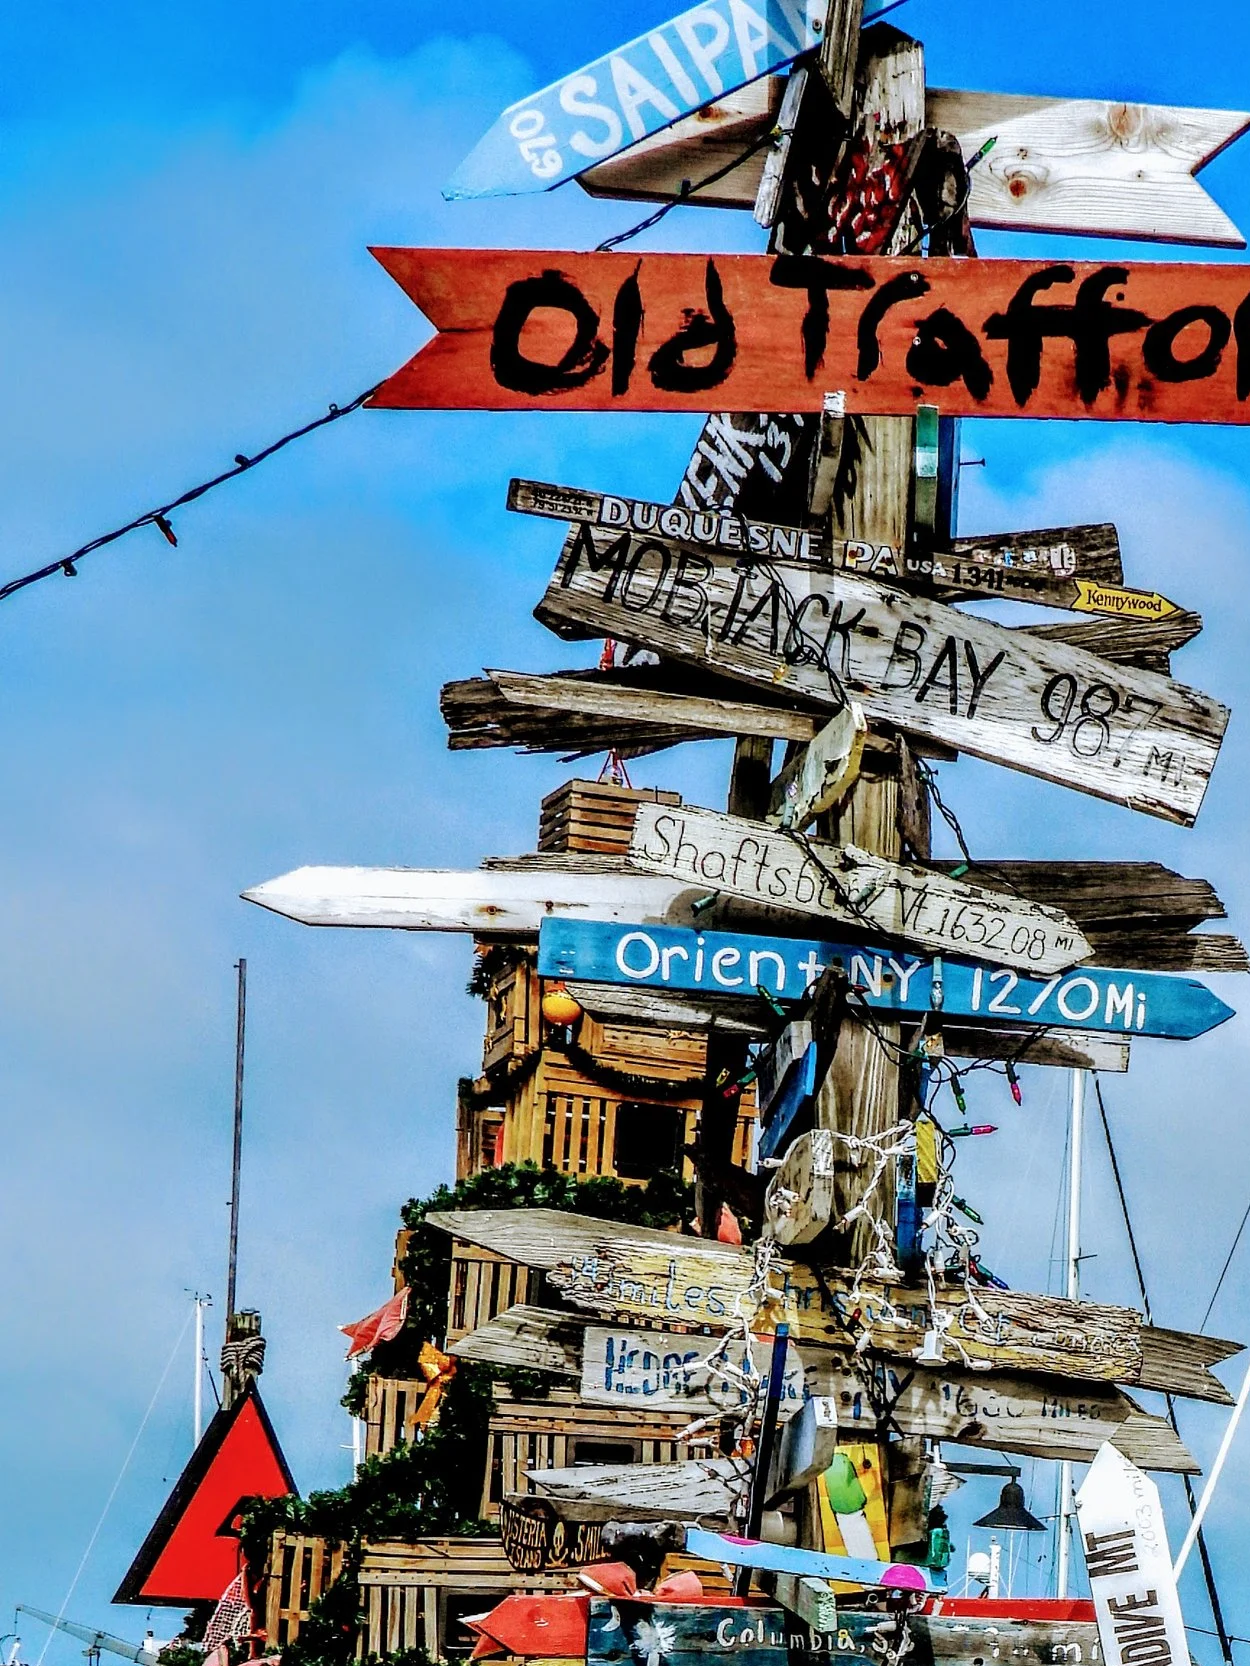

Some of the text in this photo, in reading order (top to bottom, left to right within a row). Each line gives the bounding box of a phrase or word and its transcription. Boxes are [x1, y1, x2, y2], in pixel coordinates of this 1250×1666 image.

[490, 258, 738, 396] Old
[844, 539, 899, 576] PA
[1086, 588, 1164, 614] Kennywood
[880, 620, 1006, 720] BAY
[1031, 673, 1164, 768] 987
[849, 953, 917, 1000] NY
